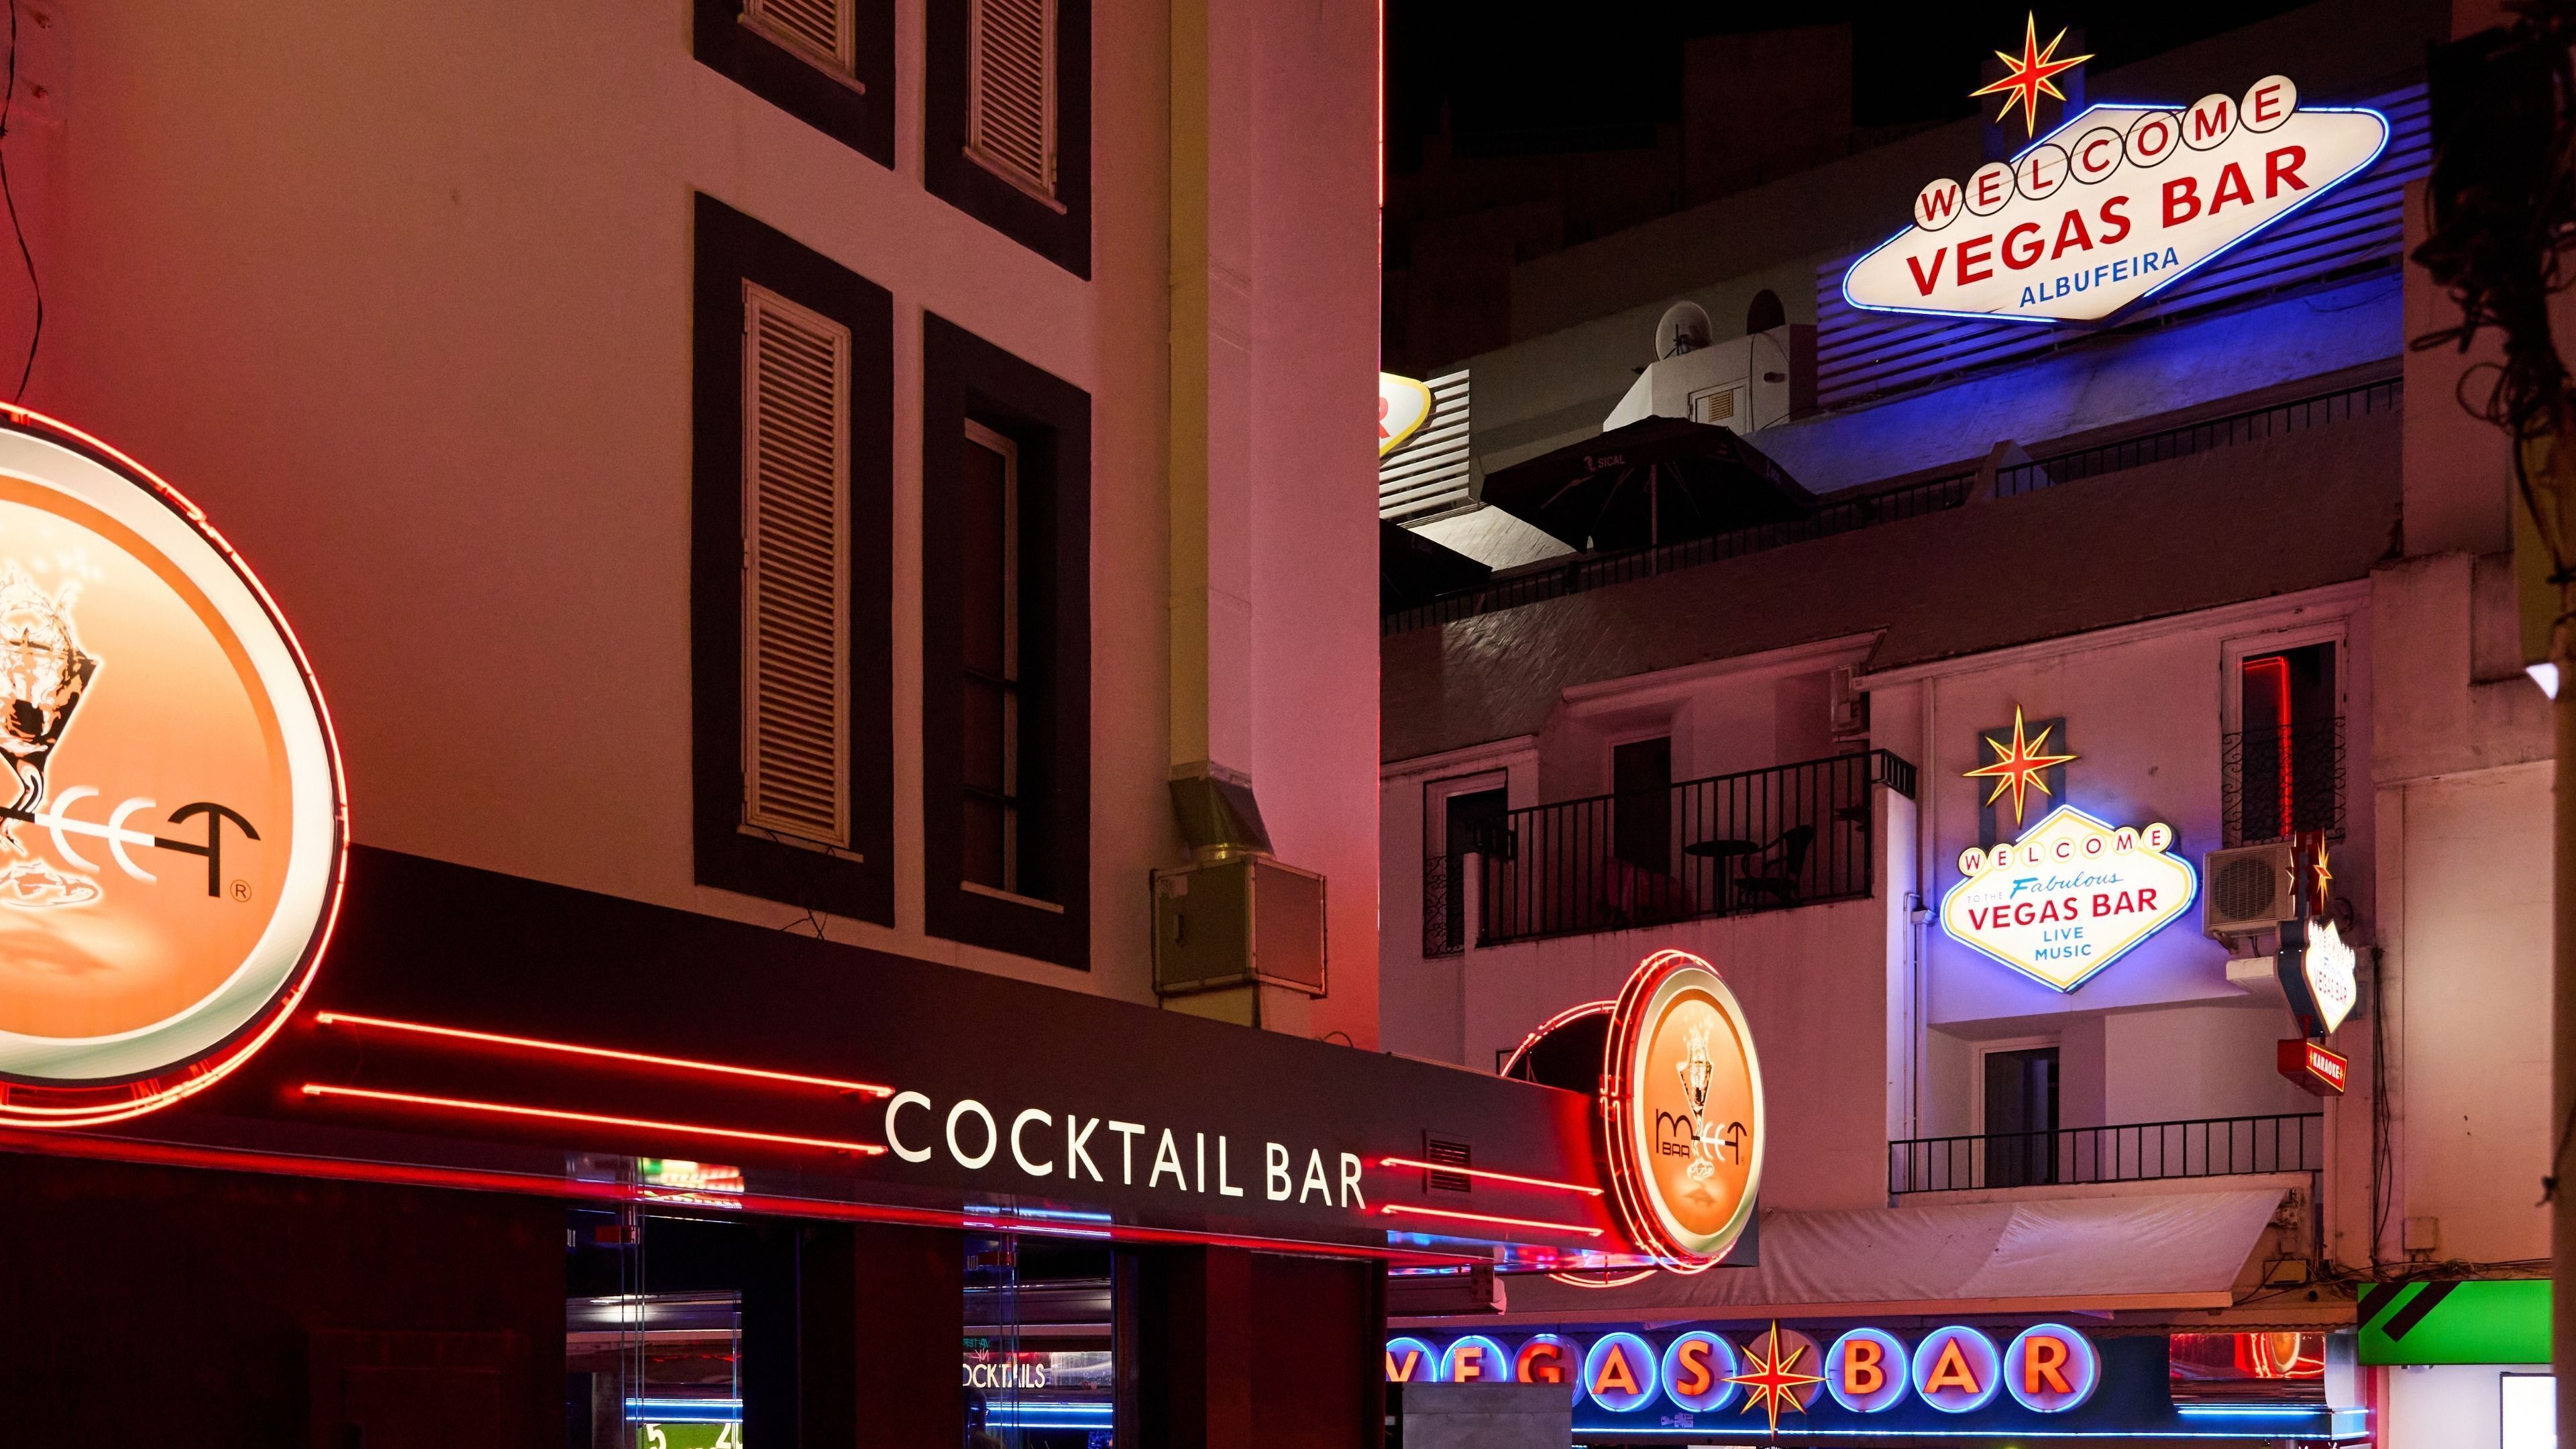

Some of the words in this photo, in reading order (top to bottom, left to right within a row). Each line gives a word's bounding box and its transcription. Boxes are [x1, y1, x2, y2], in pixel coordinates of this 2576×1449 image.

[1921, 85, 2281, 222] WELCOME
[1906, 196, 2131, 297] VEGAS
[2162, 145, 2310, 229] BAR
[2019, 247, 2180, 307] ALBUFEIRA
[1597, 454, 1627, 468] SICAL
[1965, 830, 2160, 870] WELCOME
[2009, 871, 2124, 900] Fabulous
[1968, 897, 2078, 930] VEGAS
[2092, 888, 2157, 917] BAR
[2035, 944, 2092, 961] MUSIC
[2043, 926, 2084, 942] LIVE
[2313, 1052, 2340, 1079] KARAOKE
[885, 1091, 1243, 1197] COCKTAIL
[1267, 1142, 1366, 1210] BAR
[1662, 1142, 1690, 1159] BAR
[1845, 1336, 2076, 1394] BAR
